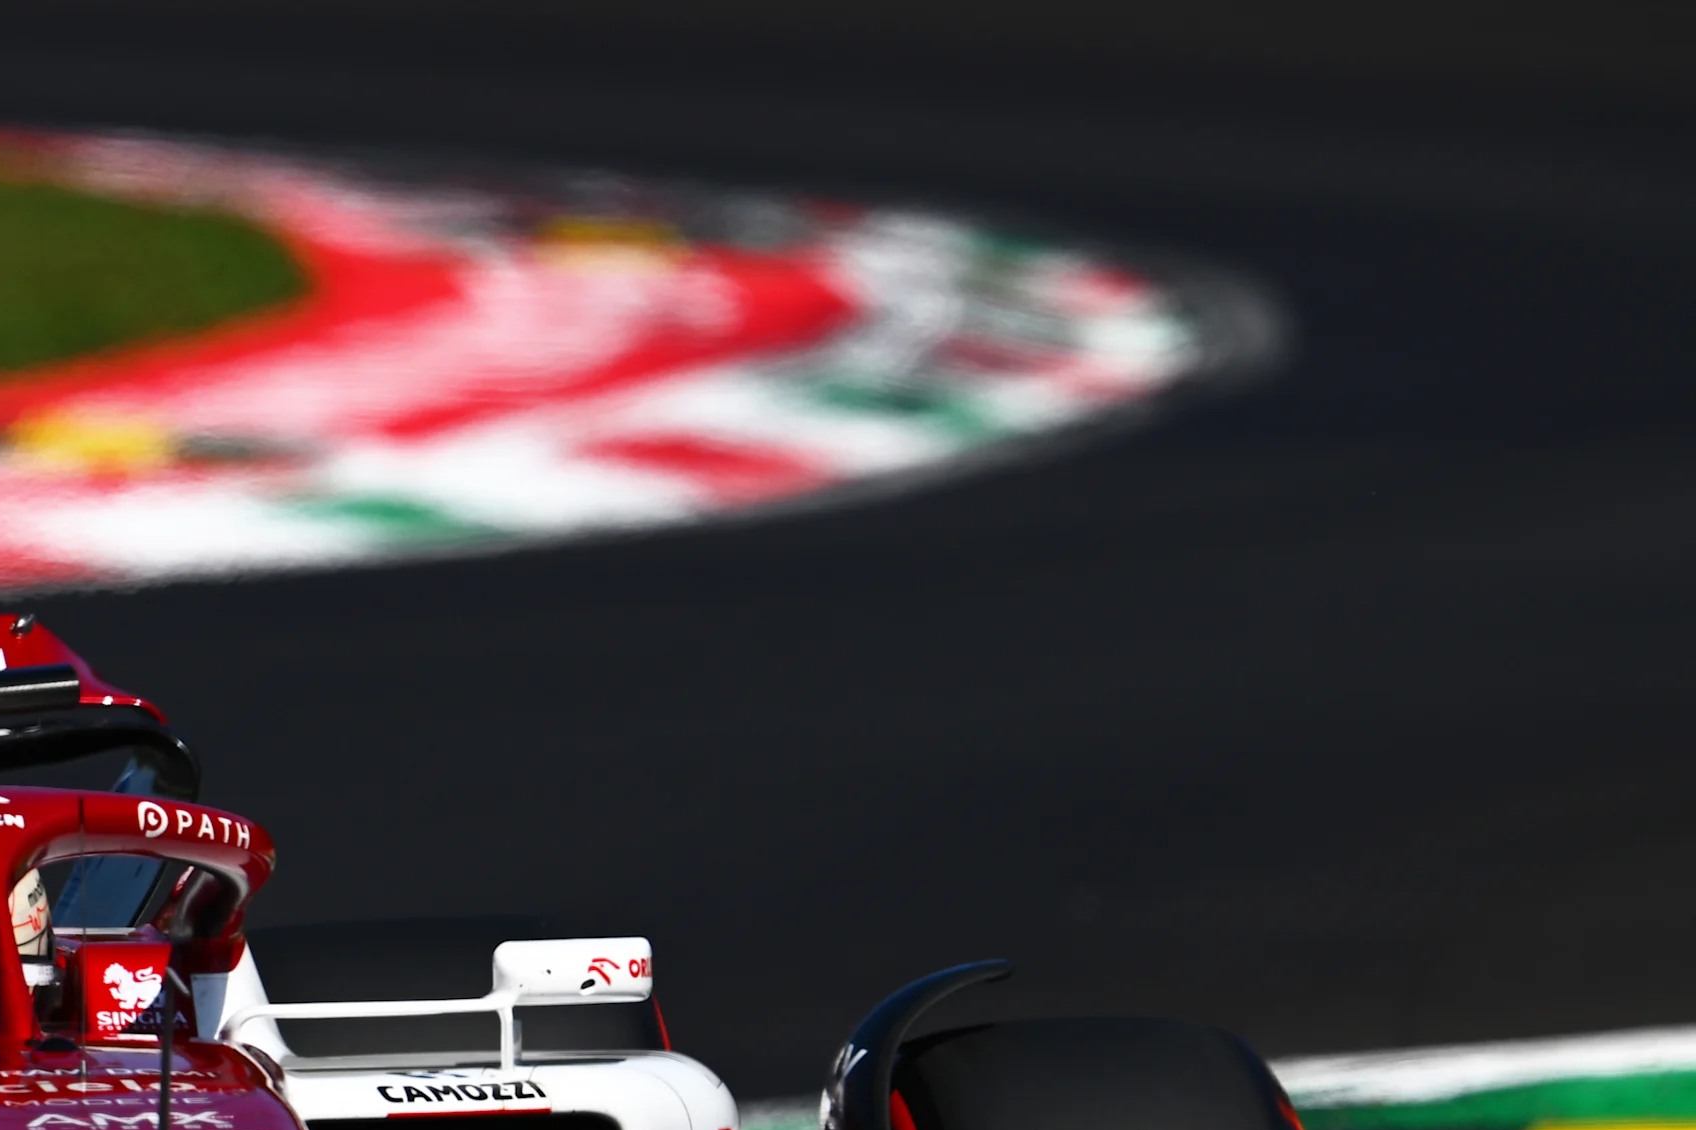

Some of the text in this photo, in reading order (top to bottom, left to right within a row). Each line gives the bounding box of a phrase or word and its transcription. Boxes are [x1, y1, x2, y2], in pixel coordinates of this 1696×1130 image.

[177, 809, 252, 850] PATH
[376, 1080, 547, 1103] CAMOZZI
[26, 1111, 230, 1127] AMX
